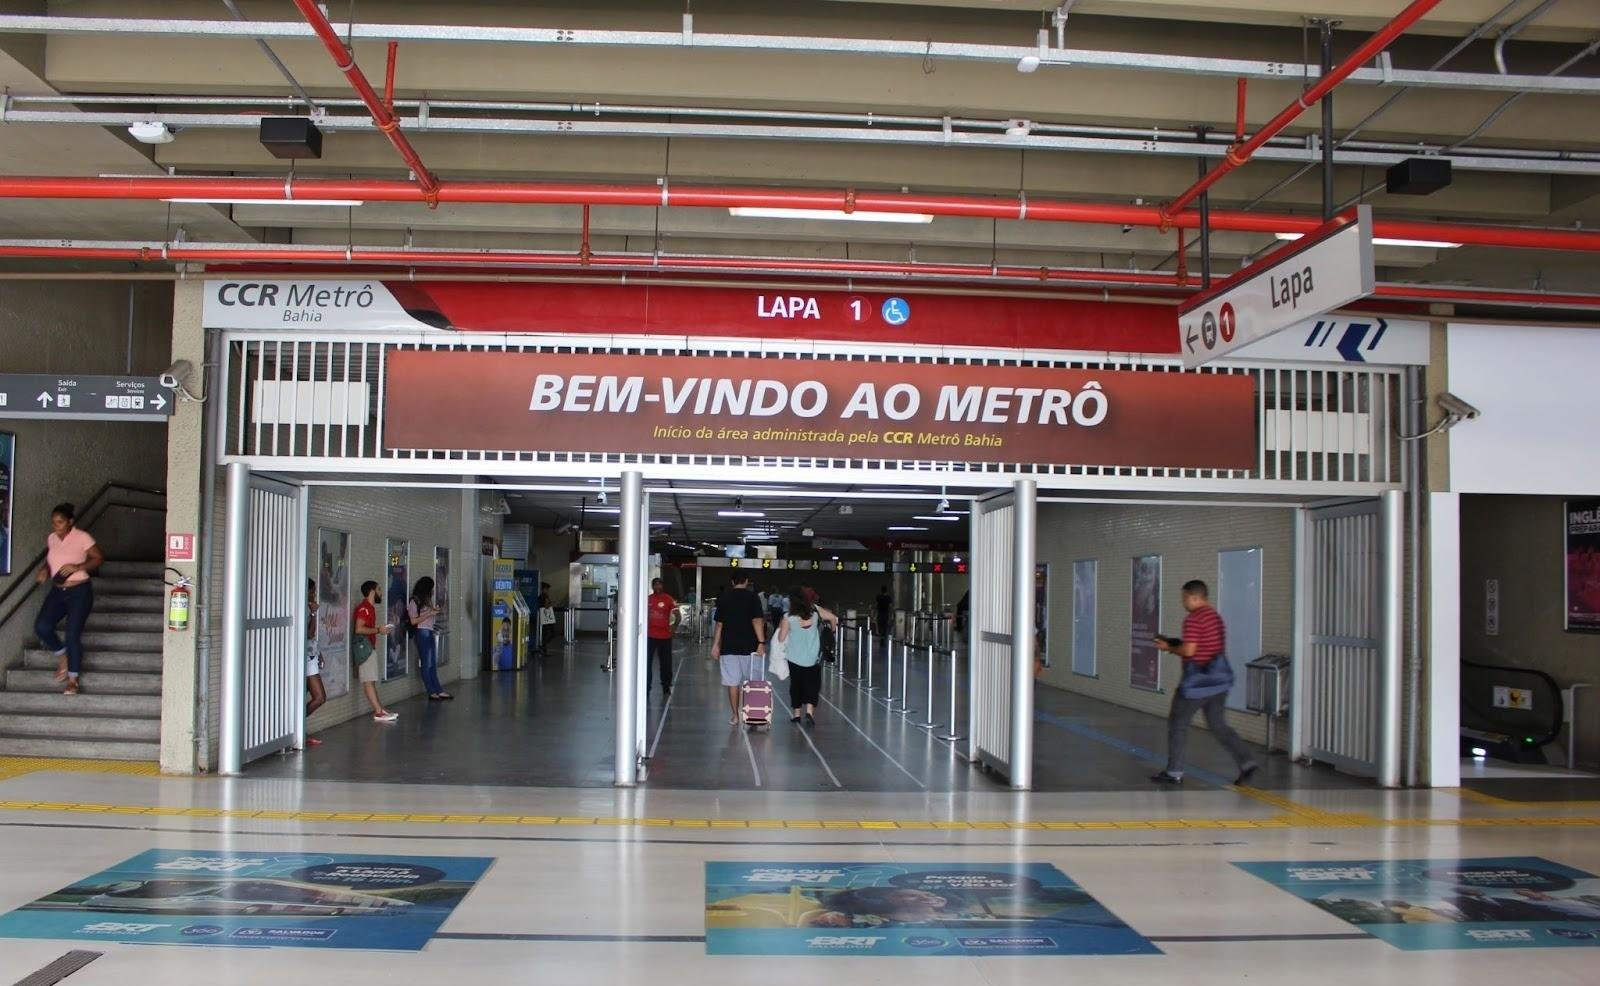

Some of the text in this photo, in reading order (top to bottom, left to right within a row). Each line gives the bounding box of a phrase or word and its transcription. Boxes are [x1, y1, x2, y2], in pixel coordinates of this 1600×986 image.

[218, 283, 374, 308] CCR Metrô
[1270, 265, 1314, 309] Lapa
[282, 309, 322, 322] Bahia
[757, 296, 862, 321] LAPA 1
[1222, 311, 1231, 336] 1
[57, 379, 77, 387] Saída
[116, 381, 145, 389] Serviços
[529, 374, 1109, 427] BEM-VINDO AO METRÔ
[653, 425, 1003, 447] Início da área administrada pela CCR Metrô Bahia
